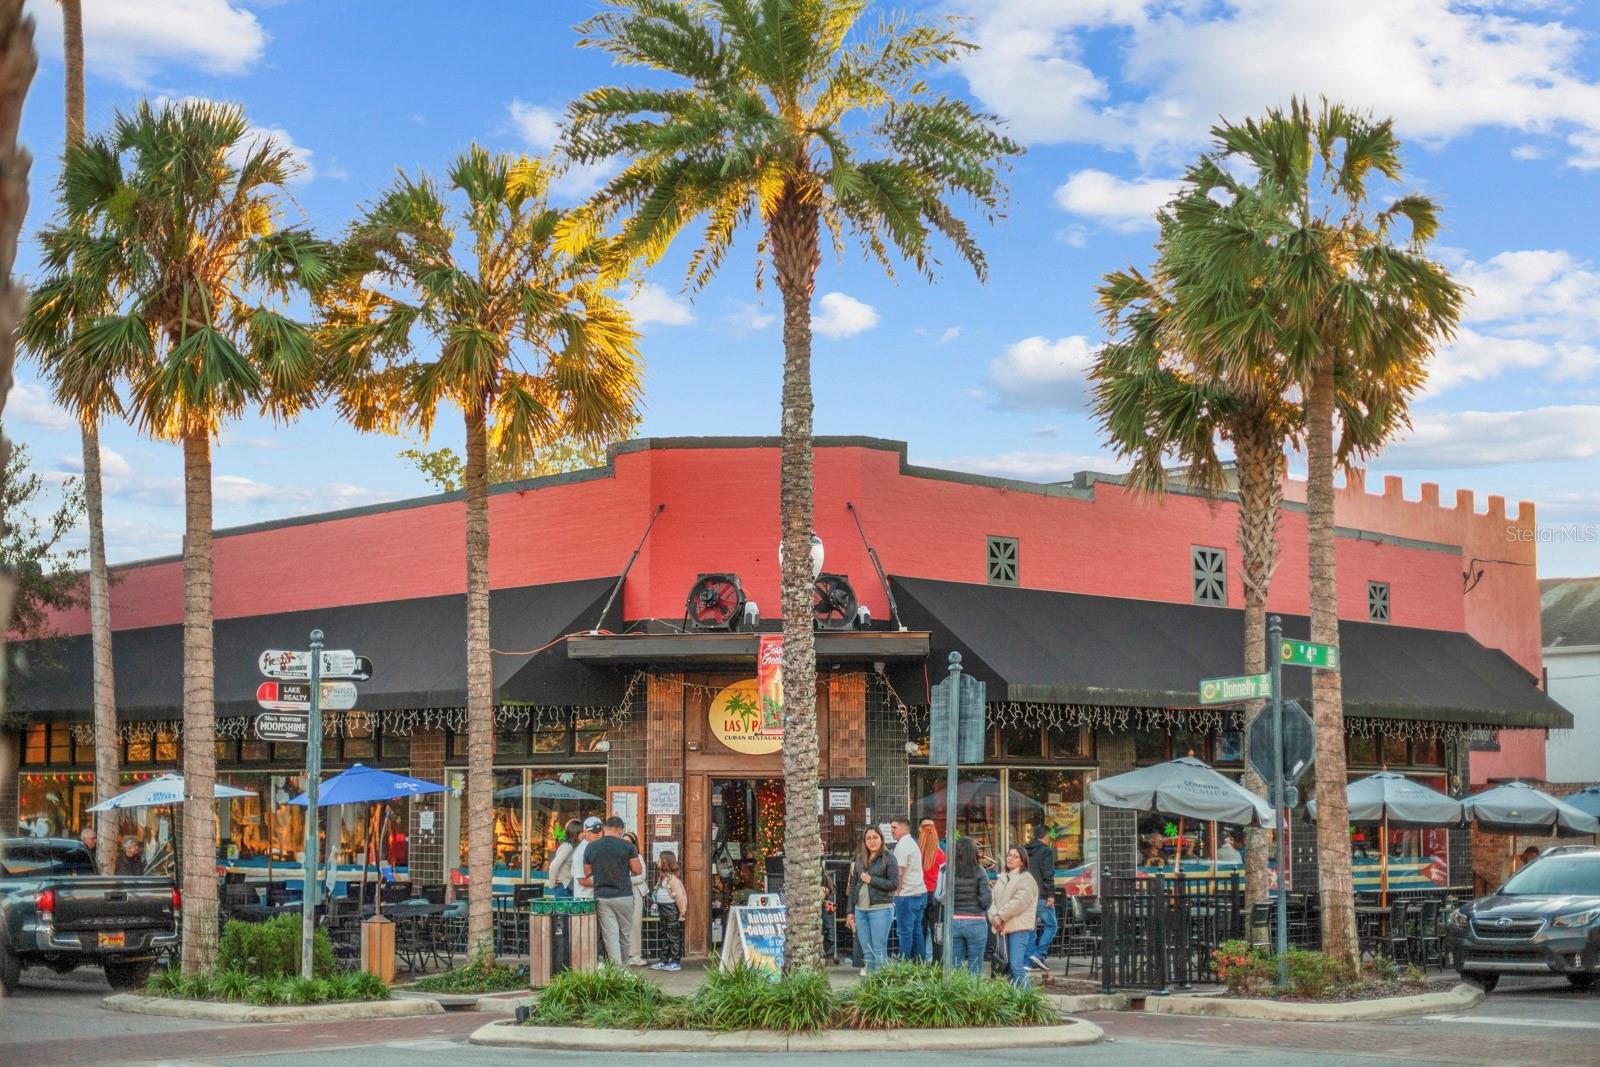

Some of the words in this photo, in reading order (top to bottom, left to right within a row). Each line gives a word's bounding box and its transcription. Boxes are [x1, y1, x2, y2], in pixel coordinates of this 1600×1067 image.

[1223, 679, 1256, 698] Donnelly
[284, 694, 307, 702] REALTY
[260, 722, 306, 732] MOONSHINE
[724, 719, 741, 732] LAS
[748, 912, 786, 925] Authenti
[747, 925, 776, 936] Cuban
